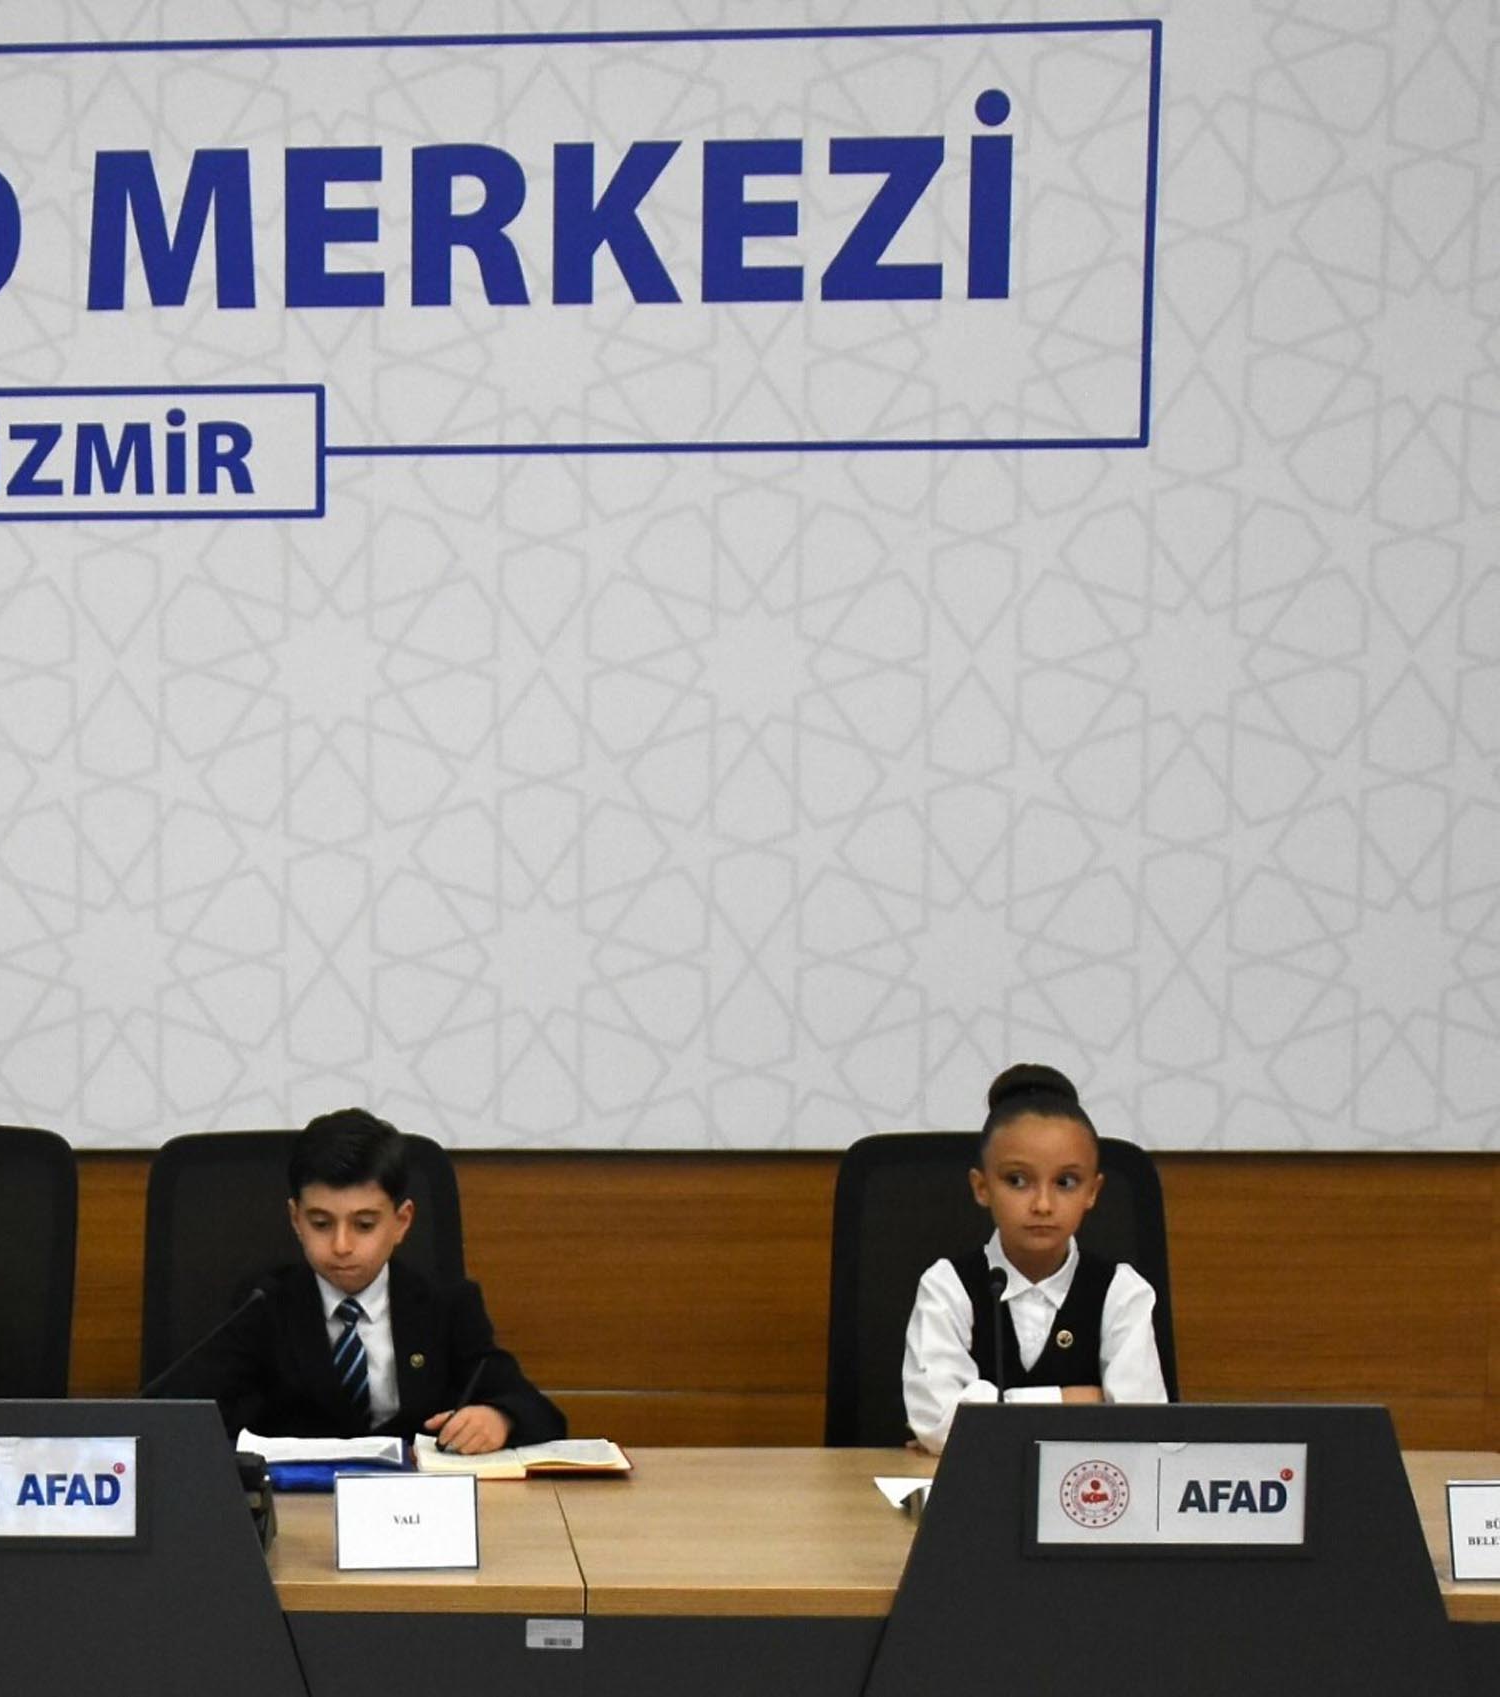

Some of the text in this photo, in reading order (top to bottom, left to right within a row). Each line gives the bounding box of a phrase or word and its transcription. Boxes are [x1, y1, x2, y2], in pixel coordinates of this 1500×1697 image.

[87, 90, 1014, 311] MERKEZİ
[17, 1473, 121, 1506] AFAD
[1178, 1480, 1288, 1514] AFAD
[392, 1512, 420, 1525] VALİ
